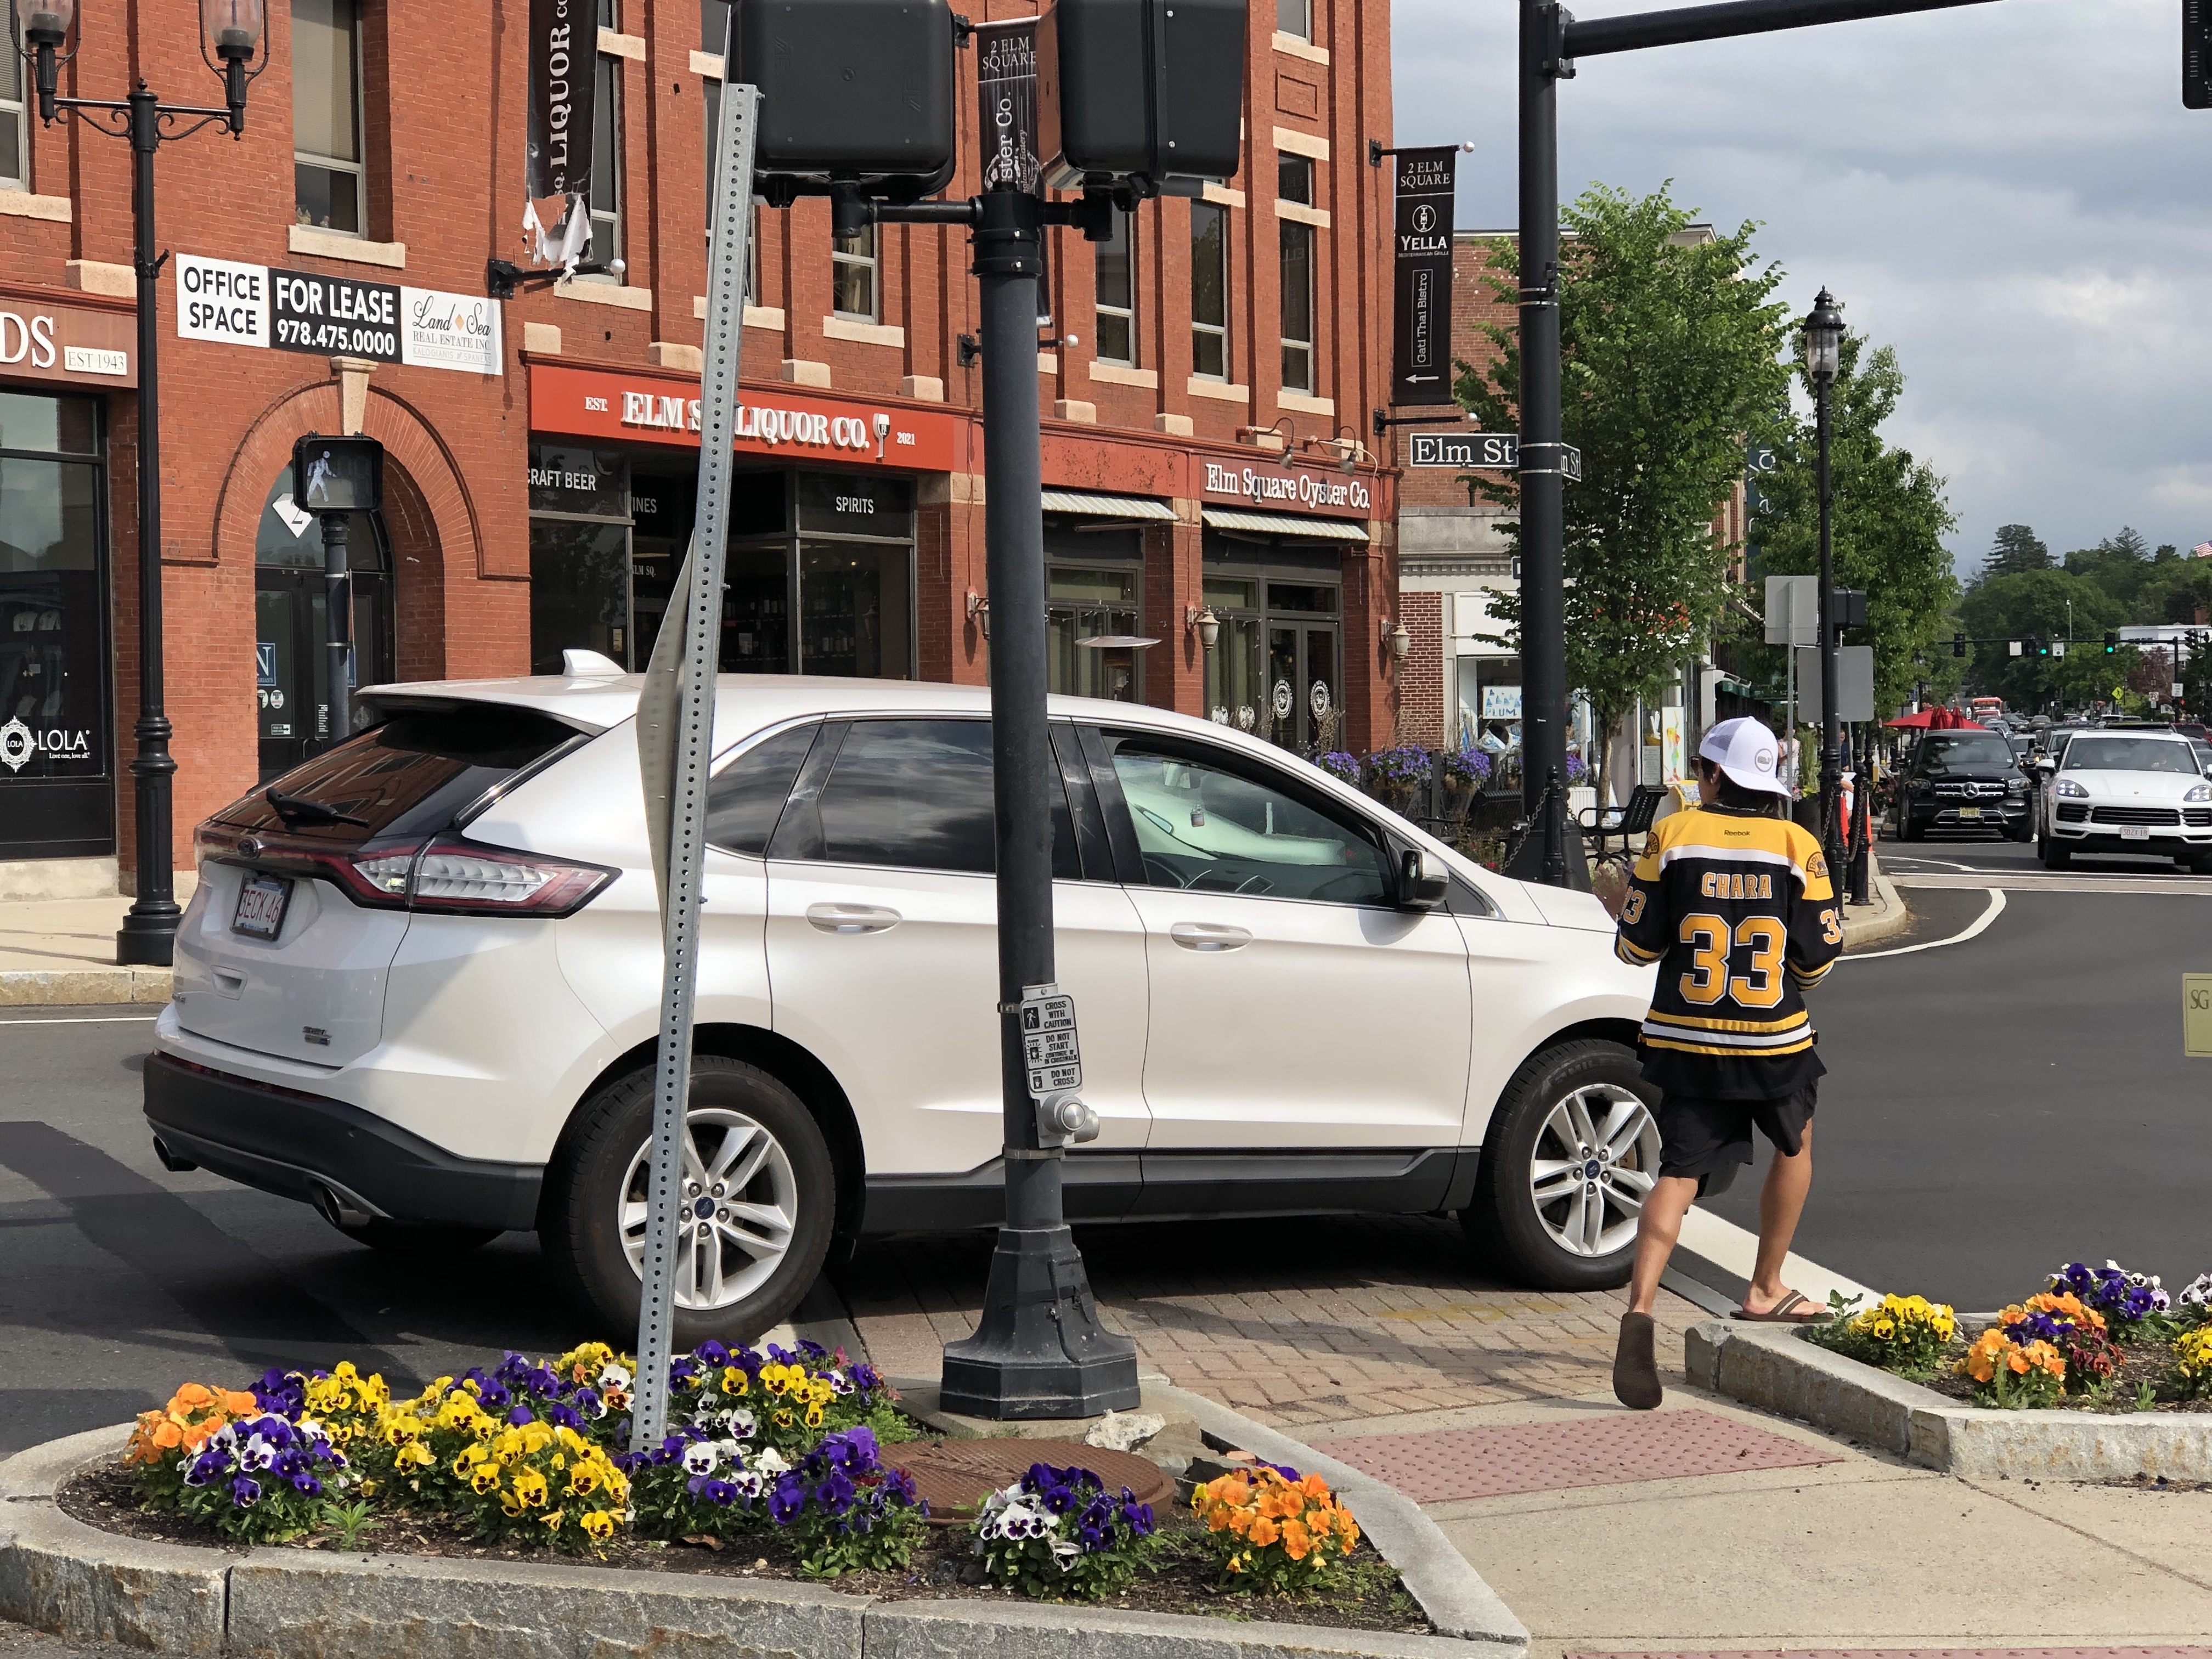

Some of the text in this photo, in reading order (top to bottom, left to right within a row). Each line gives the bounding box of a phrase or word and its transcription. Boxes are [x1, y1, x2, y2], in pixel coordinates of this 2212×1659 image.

[990, 36, 1030, 53] 2 ELM
[983, 51, 1036, 71] SQUARE
[550, 23, 571, 168] LIQUOR
[996, 92, 1013, 182] ster Co.
[1408, 161, 1443, 173] 2 ELM
[1401, 173, 1451, 188] SQUARE
[1401, 236, 1447, 251] YELLA
[184, 267, 261, 301] OFFICE
[1417, 273, 1427, 308] Bistro
[276, 276, 394, 325] FOR LEASE
[189, 302, 257, 335] SPACE
[413, 296, 492, 336] Land Sea
[1417, 311, 1426, 337] Thai
[277, 319, 395, 356] 978.475.0000
[413, 330, 492, 351] REAL ESTATE INC.
[68, 351, 124, 370] EST 1943
[413, 347, 454, 359] KALOGIANIS
[464, 353, 492, 364] SPANEAS
[585, 397, 608, 412] EST.
[621, 391, 685, 429] ELM
[734, 405, 830, 445] LIQUOR
[830, 416, 870, 449] CO.
[897, 432, 916, 445] 2021
[1415, 437, 1514, 463] Elm St
[1570, 452, 1580, 476] St
[565, 472, 596, 492] BEER
[1206, 463, 1370, 509] Elm Square Oyster Co.
[631, 496, 874, 515] INES SPIRITS
[1485, 708, 1517, 716] PLUM
[38, 729, 88, 751] LOLA
[1702, 872, 1772, 899] CHARA
[265, 895, 284, 923] 46
[1679, 913, 1787, 1009] 33
[1045, 1000, 1066, 1010] CROSS
[1048, 1009, 1065, 1019] WITH
[1044, 1018, 1071, 1029] CAUTION
[1046, 1035, 1055, 1043] DO
[1057, 1032, 1070, 1041] NOT
[1048, 1041, 1069, 1051] START
[1051, 1070, 1060, 1079] DO
[1062, 1068, 1076, 1077] NOT
[1053, 1076, 1075, 1086] CROSS
